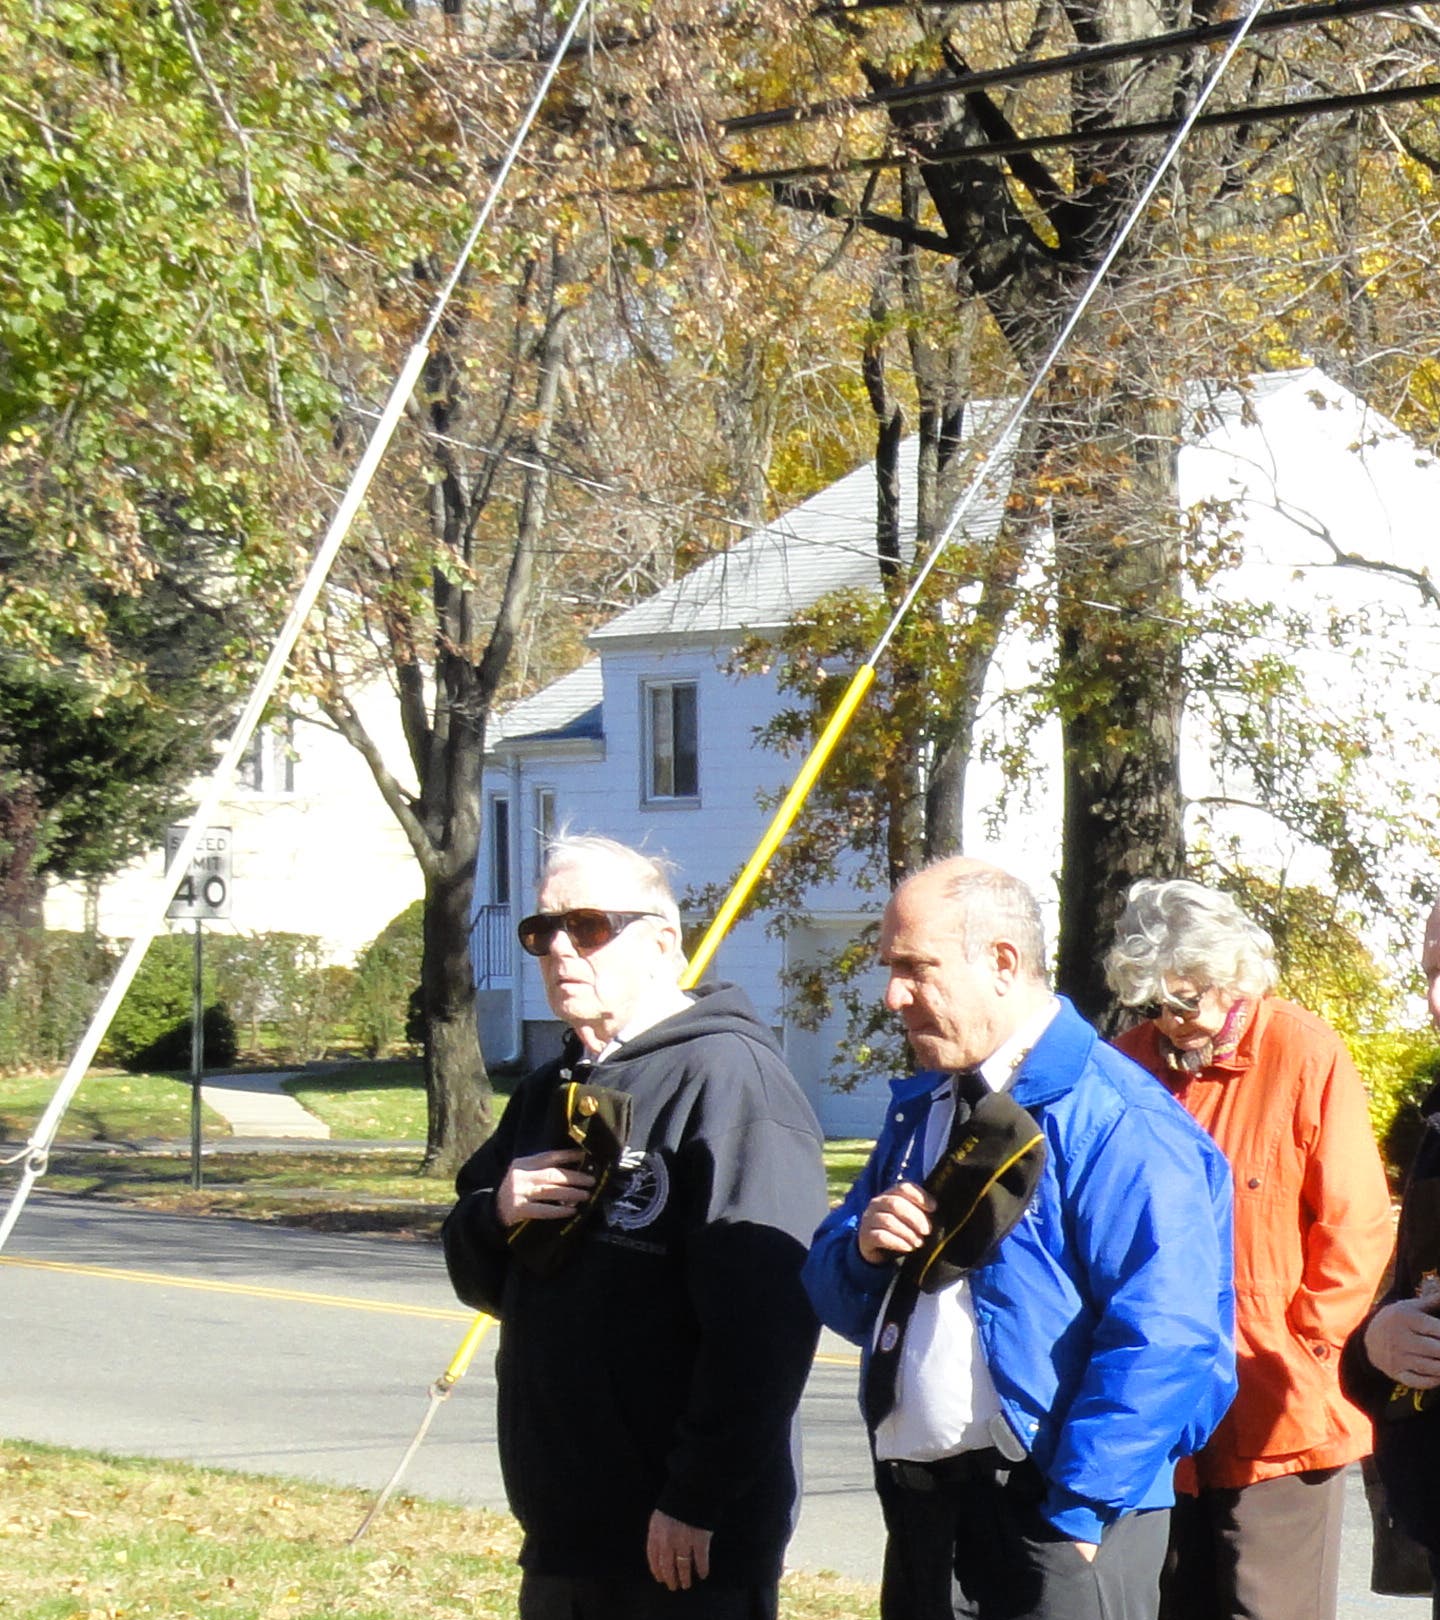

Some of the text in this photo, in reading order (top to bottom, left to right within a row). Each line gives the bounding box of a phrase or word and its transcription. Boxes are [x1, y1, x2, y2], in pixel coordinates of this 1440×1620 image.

[170, 836, 227, 852] SEED
[192, 855, 222, 872] MIT
[173, 874, 226, 909] 40
